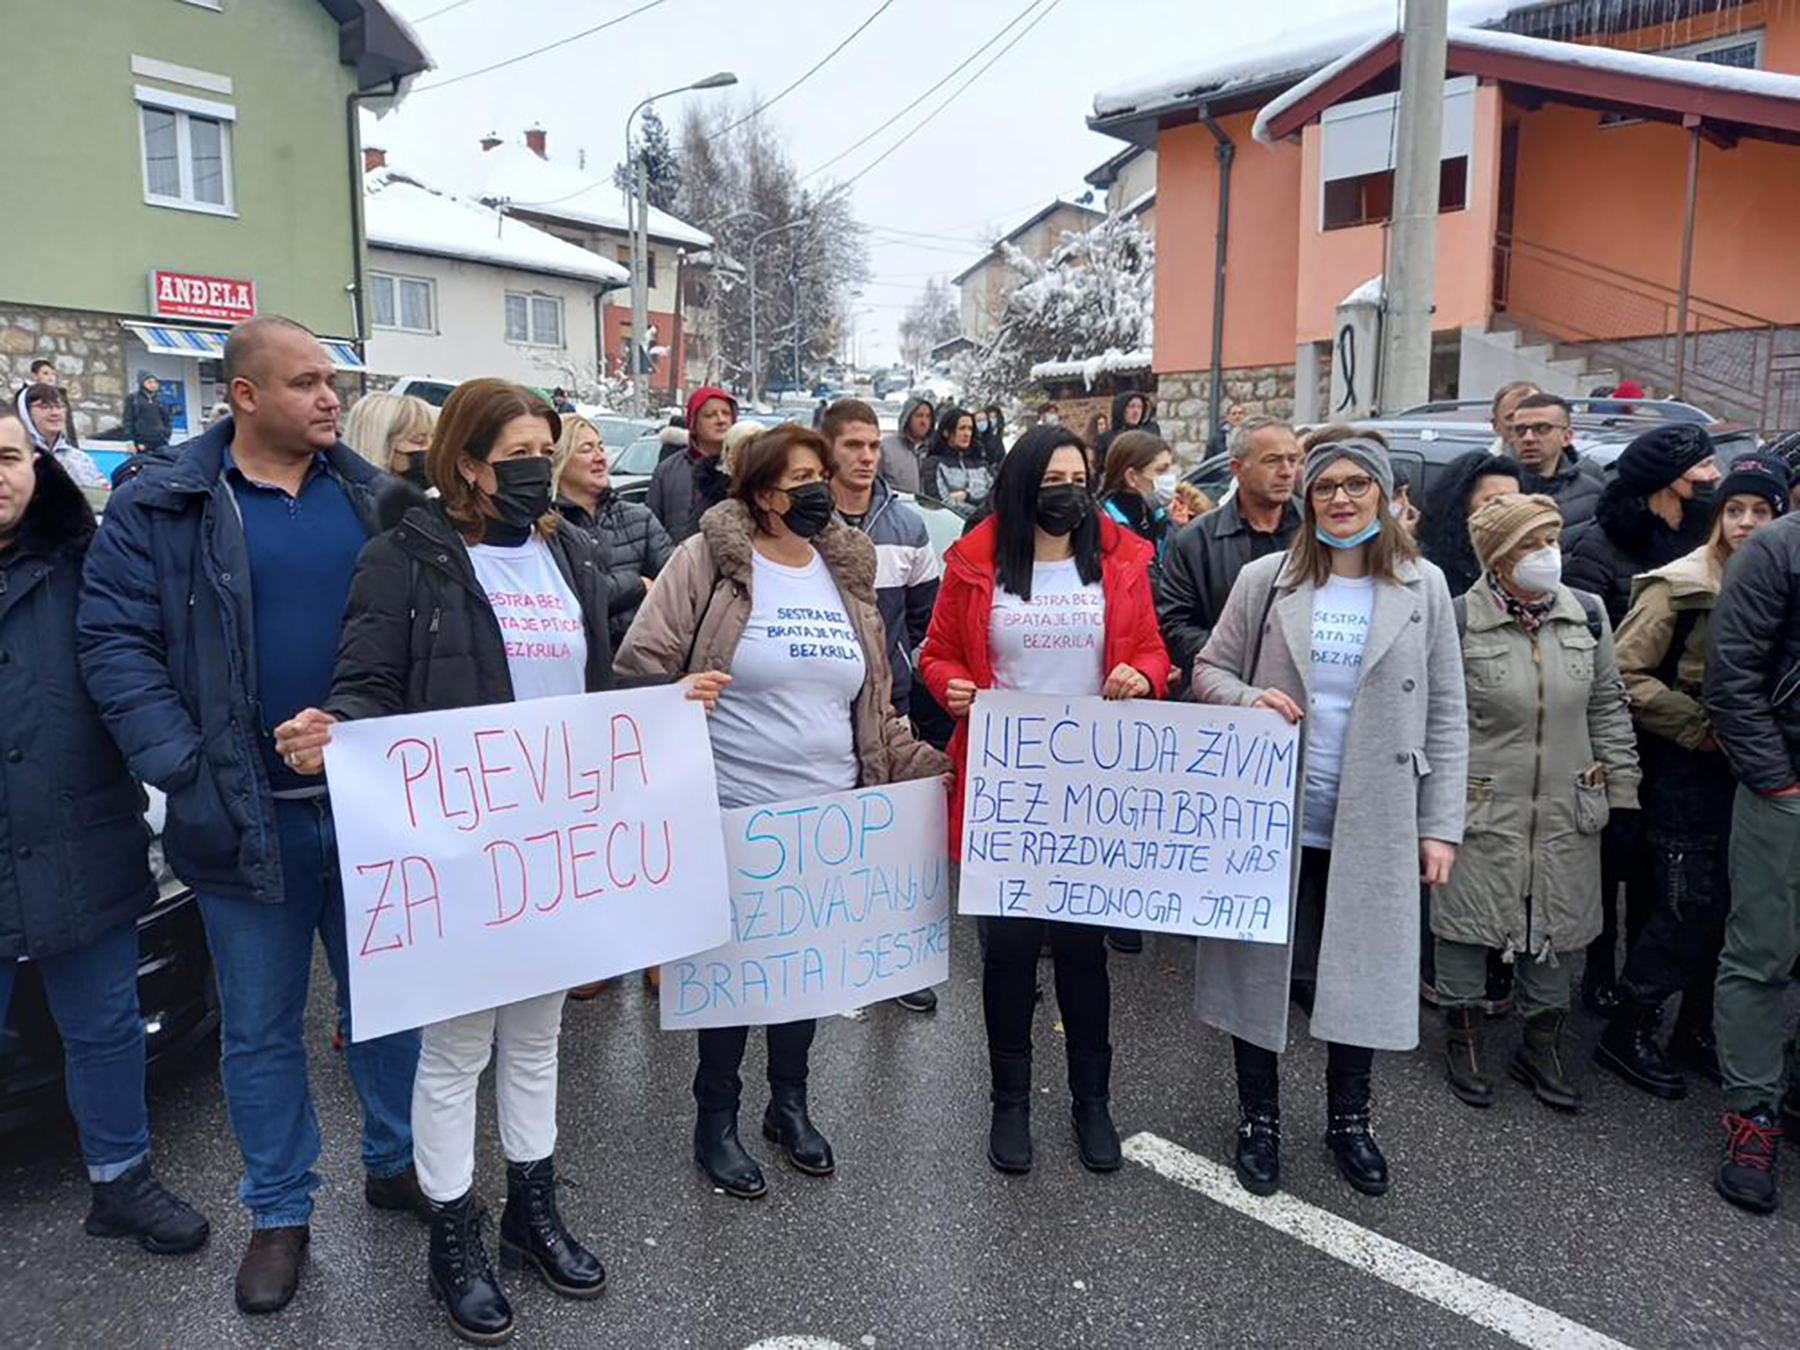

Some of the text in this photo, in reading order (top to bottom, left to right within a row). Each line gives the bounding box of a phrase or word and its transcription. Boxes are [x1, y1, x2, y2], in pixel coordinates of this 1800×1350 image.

[158, 276, 252, 310] ANĐELA
[488, 592, 535, 607] ESTRA
[1071, 593, 1099, 606] BEZ
[777, 607, 846, 624] SESTRA BEZ
[1071, 611, 1102, 627] PTIC
[1313, 611, 1368, 626] SESTRA
[1023, 633, 1095, 649] BEZ KRILA
[1311, 629, 1344, 643] ATA
[505, 641, 571, 659] EZ KRILA
[789, 644, 860, 662] BEZ KRILA
[1127, 721, 1180, 774] DA
[969, 777, 1291, 850] BEZ MOGA BRATA
[737, 791, 894, 880] STOP
[968, 830, 1280, 875] NE RAZDVAJAJTE NAS
[356, 820, 671, 957] ZA DJECU
[999, 874, 1272, 930] IZ JEDNOGA JATA
[674, 946, 825, 1017] BRATA
